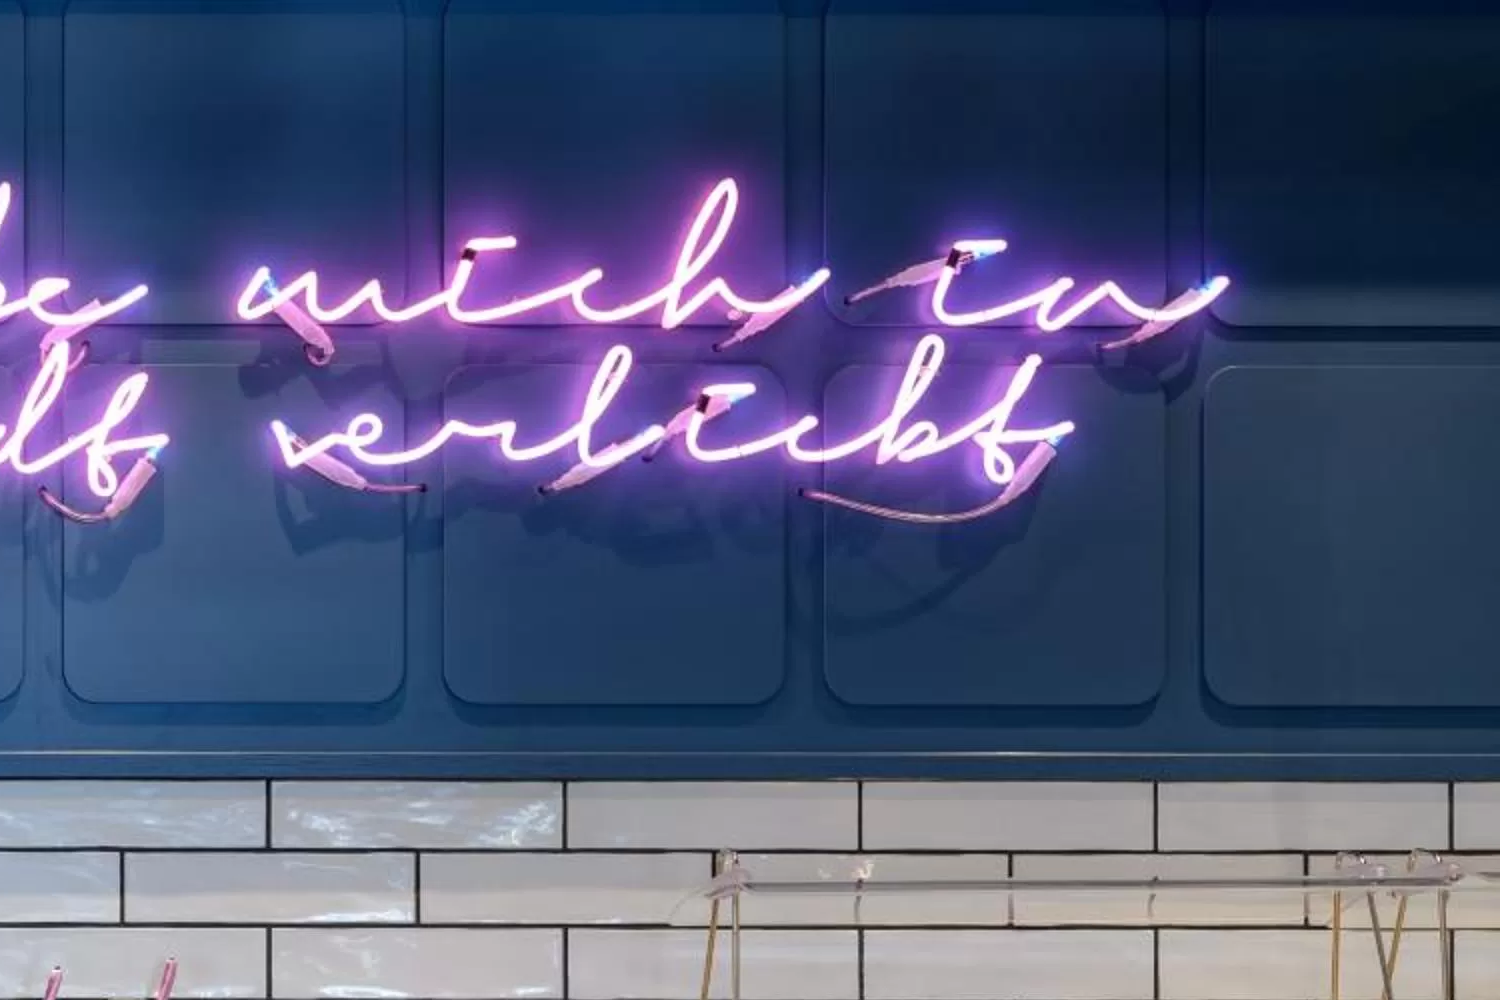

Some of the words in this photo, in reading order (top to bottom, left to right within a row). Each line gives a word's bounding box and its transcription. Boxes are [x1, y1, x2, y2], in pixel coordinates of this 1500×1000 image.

[236, 177, 831, 328] mich
[932, 237, 1230, 328] in
[271, 334, 1076, 484] verliebt
